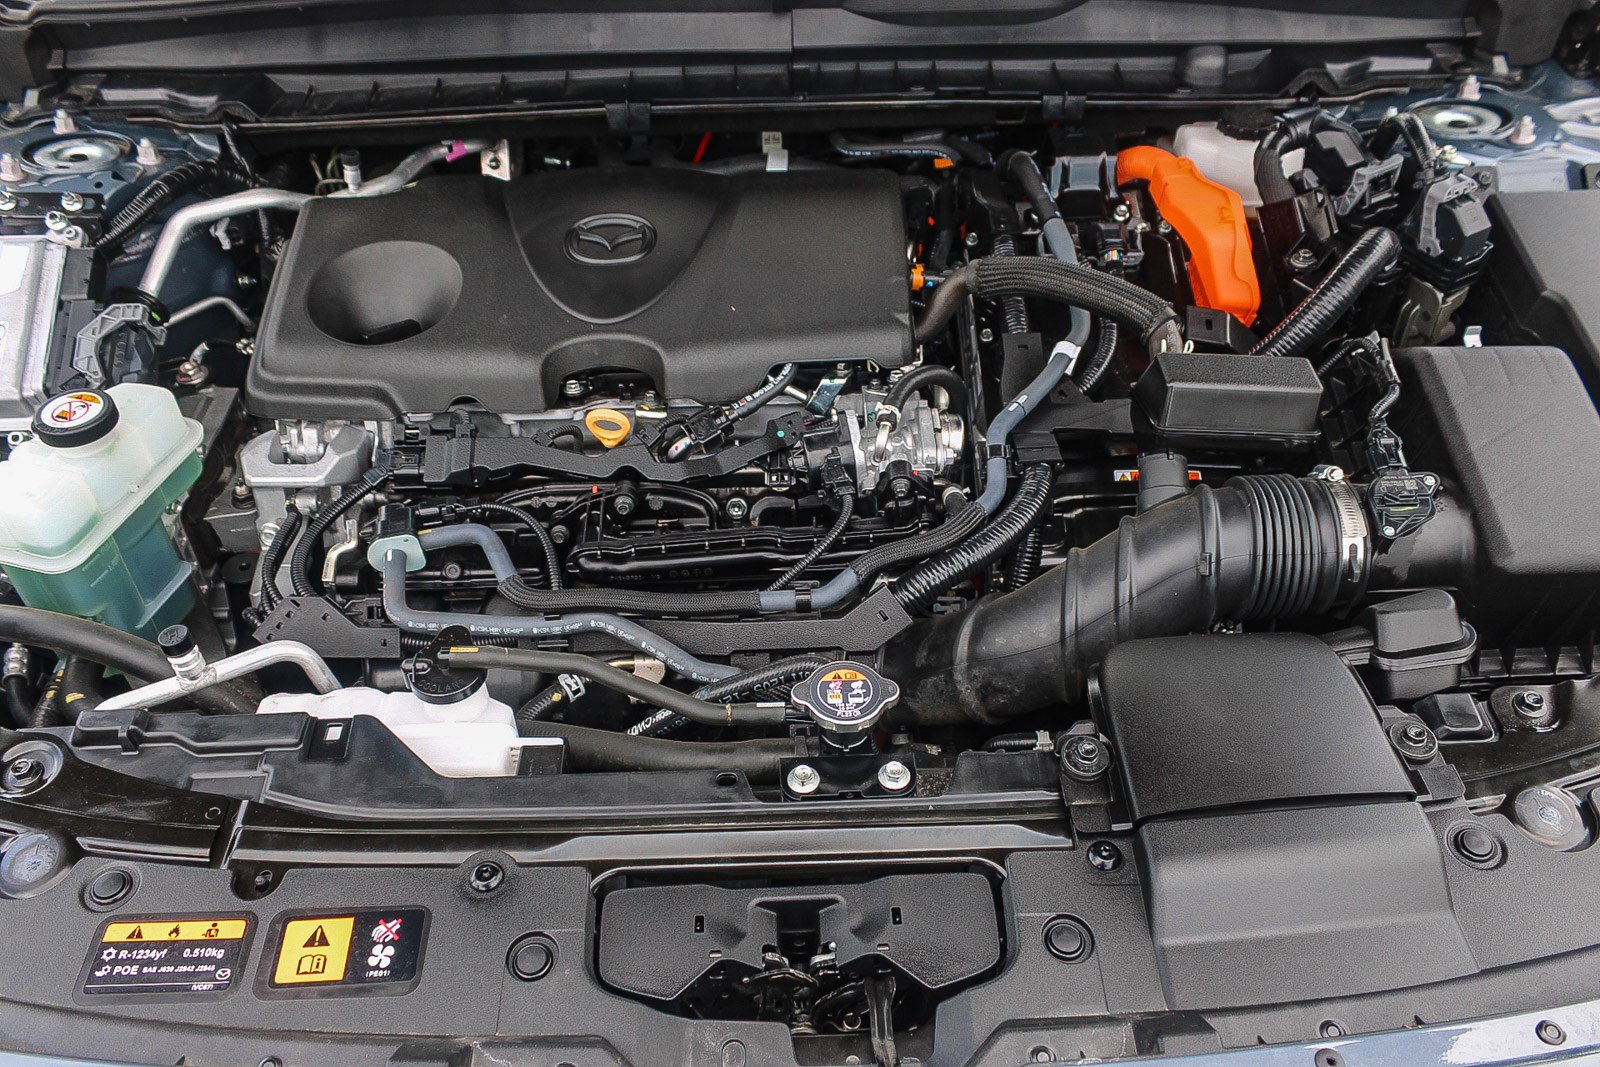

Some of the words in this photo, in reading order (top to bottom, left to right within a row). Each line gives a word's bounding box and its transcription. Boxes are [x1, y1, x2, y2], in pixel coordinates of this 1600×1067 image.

[118, 949, 168, 961] R-1234yf
[182, 947, 225, 959] 0.510kg
[112, 965, 140, 976] POE
